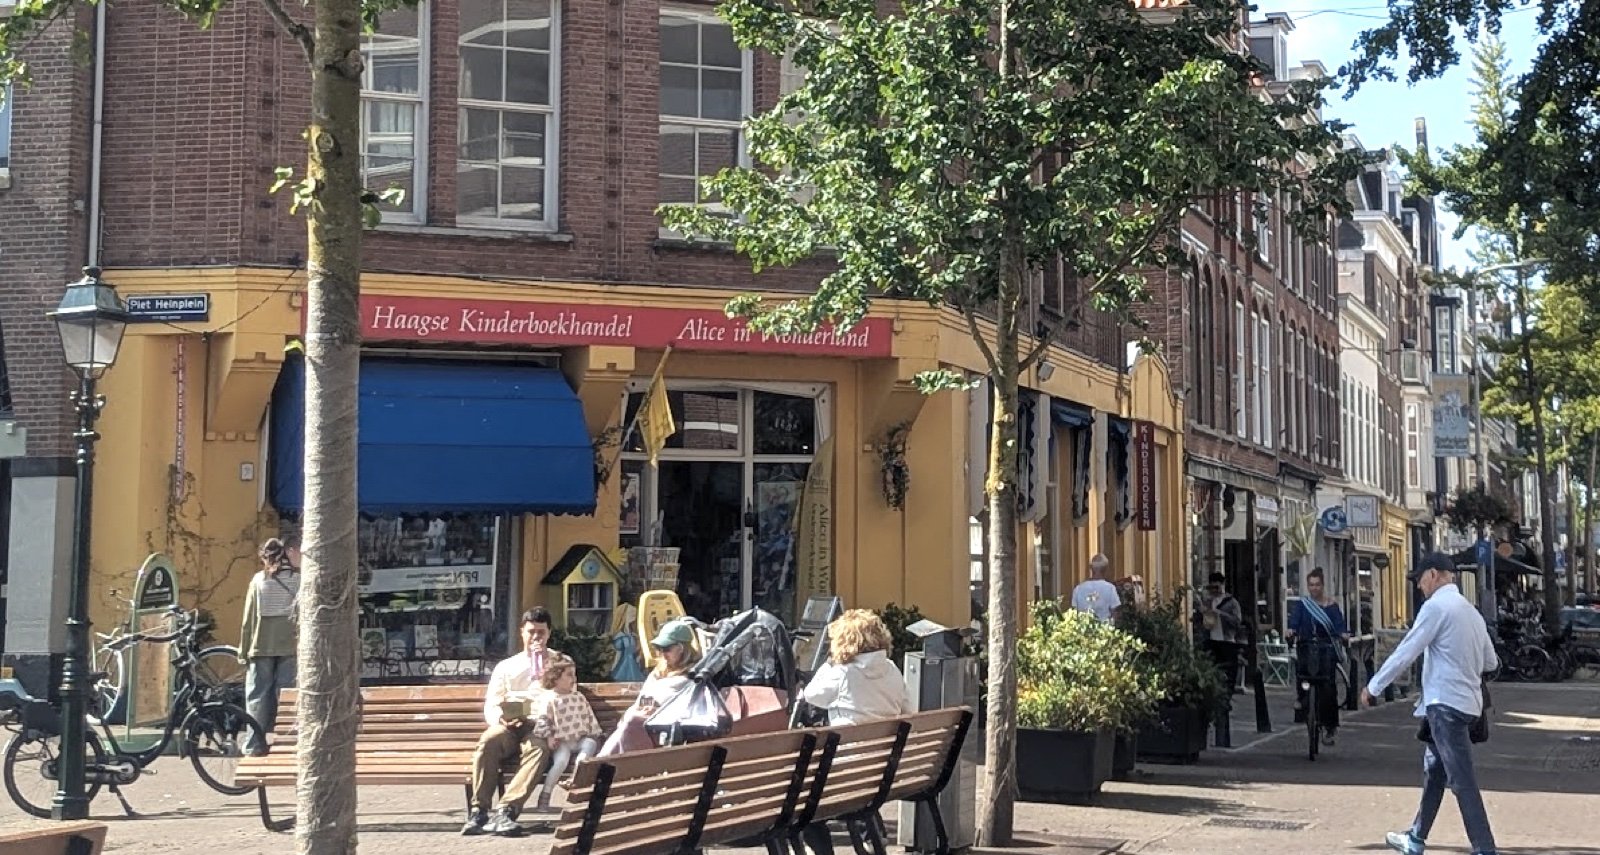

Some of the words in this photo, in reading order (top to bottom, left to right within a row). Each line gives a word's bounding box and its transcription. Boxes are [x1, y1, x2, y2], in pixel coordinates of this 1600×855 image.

[130, 300, 151, 310] Piet
[155, 299, 204, 310] Heinplein
[371, 305, 450, 336] Haagse
[458, 308, 633, 337] Kinderboekhandel
[676, 318, 726, 341] Alice
[734, 322, 750, 343] in
[1141, 424, 1151, 528] KINDERBOEKEN
